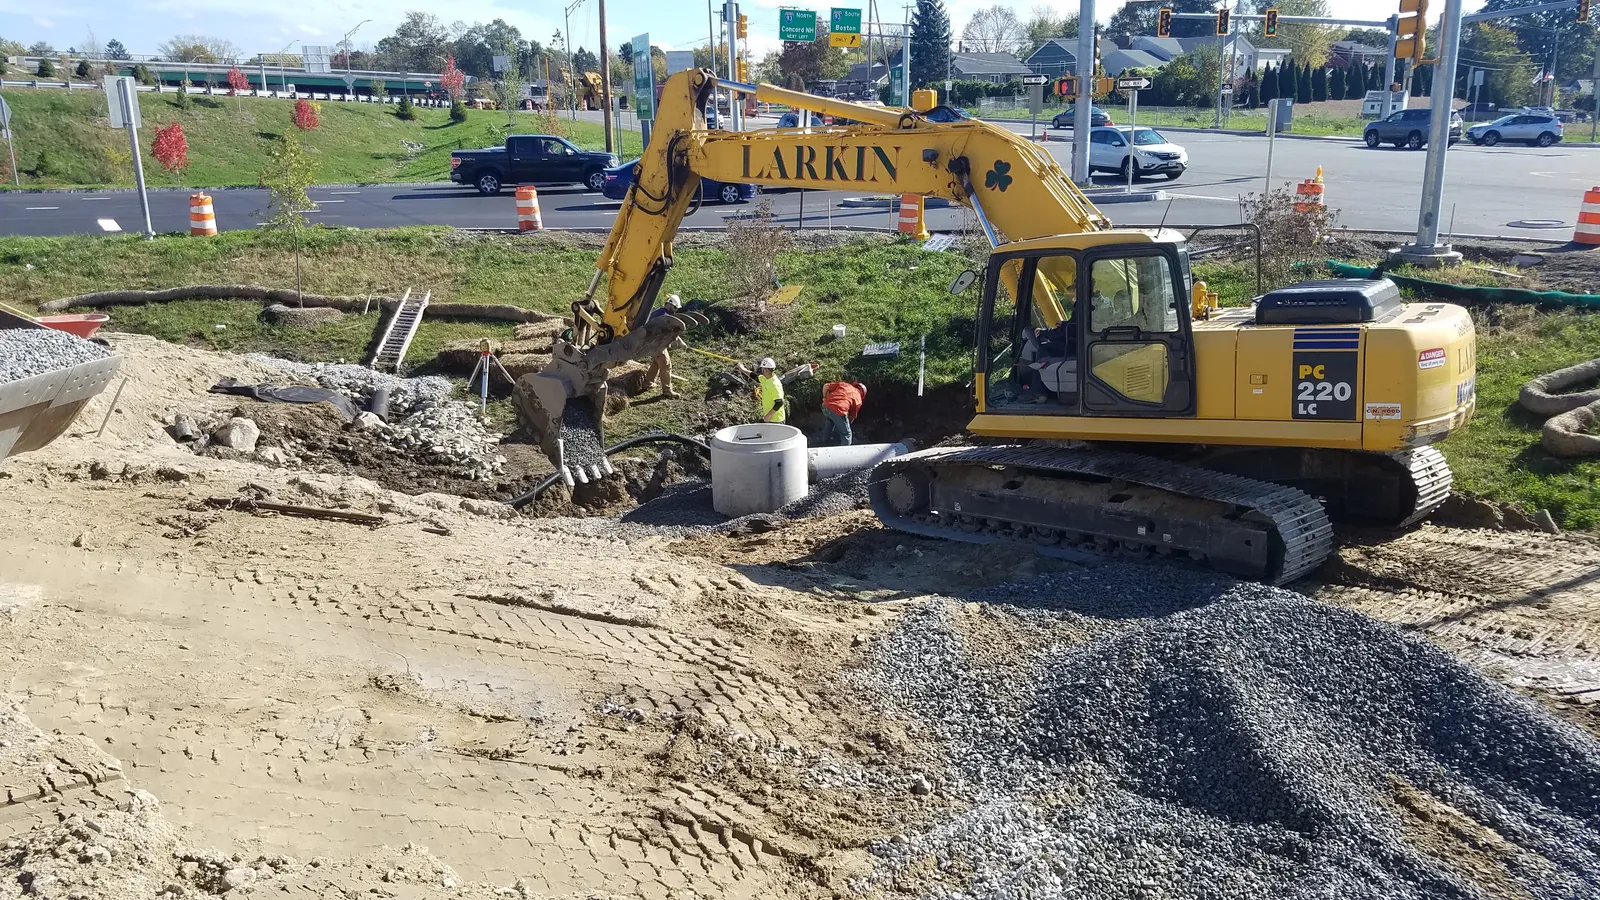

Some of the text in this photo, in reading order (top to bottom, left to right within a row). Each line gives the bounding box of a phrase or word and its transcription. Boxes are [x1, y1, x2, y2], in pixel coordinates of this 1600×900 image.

[781, 25, 804, 33] Concord
[741, 144, 903, 184] LARKIN
[1425, 349, 1445, 360] DANGER
[1299, 364, 1325, 380] PC
[1297, 381, 1352, 402] 220
[1298, 403, 1317, 415] LC
